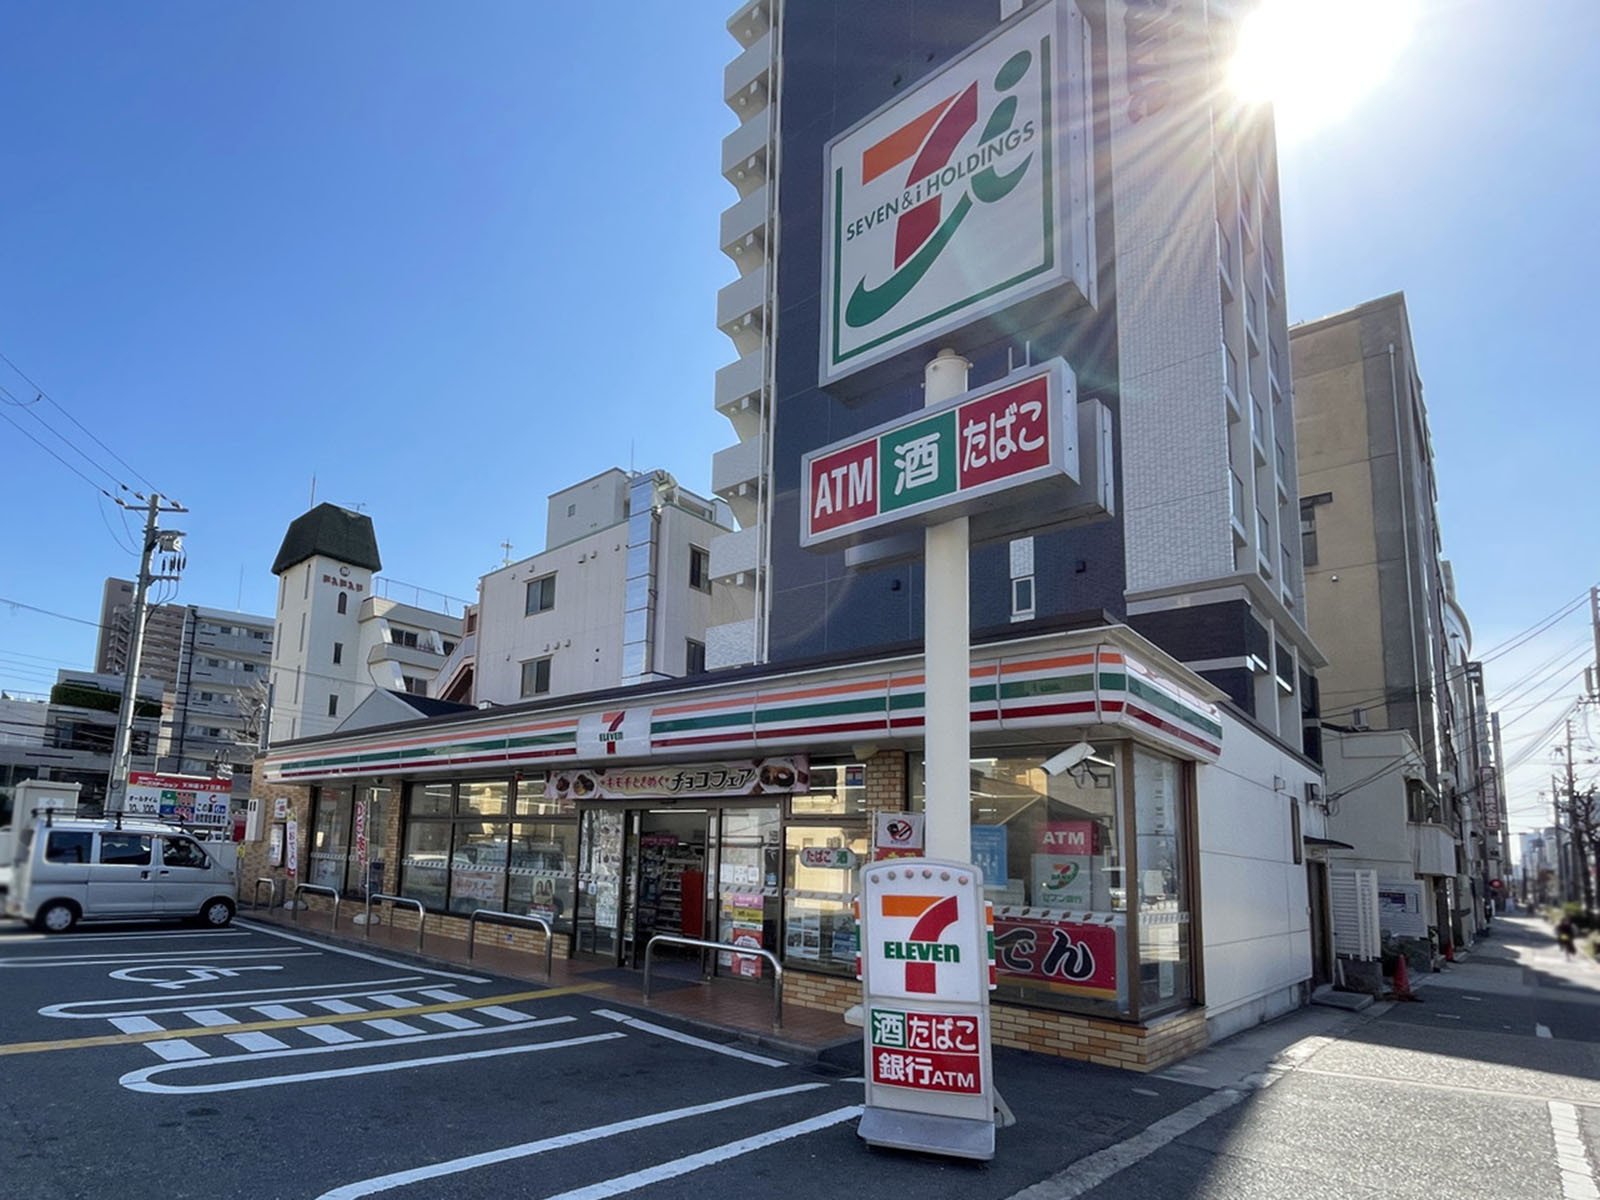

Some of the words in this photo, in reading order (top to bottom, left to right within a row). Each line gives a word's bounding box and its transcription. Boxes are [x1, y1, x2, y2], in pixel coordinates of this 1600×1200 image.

[927, 121, 1034, 198] HOLDINGS
[962, 400, 1044, 472] たばこ
[814, 456, 873, 519] ATM
[894, 431, 941, 496] 酒
[668, 768, 756, 791] チョコフェア
[805, 848, 832, 864] たばこ
[1043, 831, 1085, 845] ATM
[873, 1011, 905, 1047] 酒
[908, 1015, 978, 1052] たばこ
